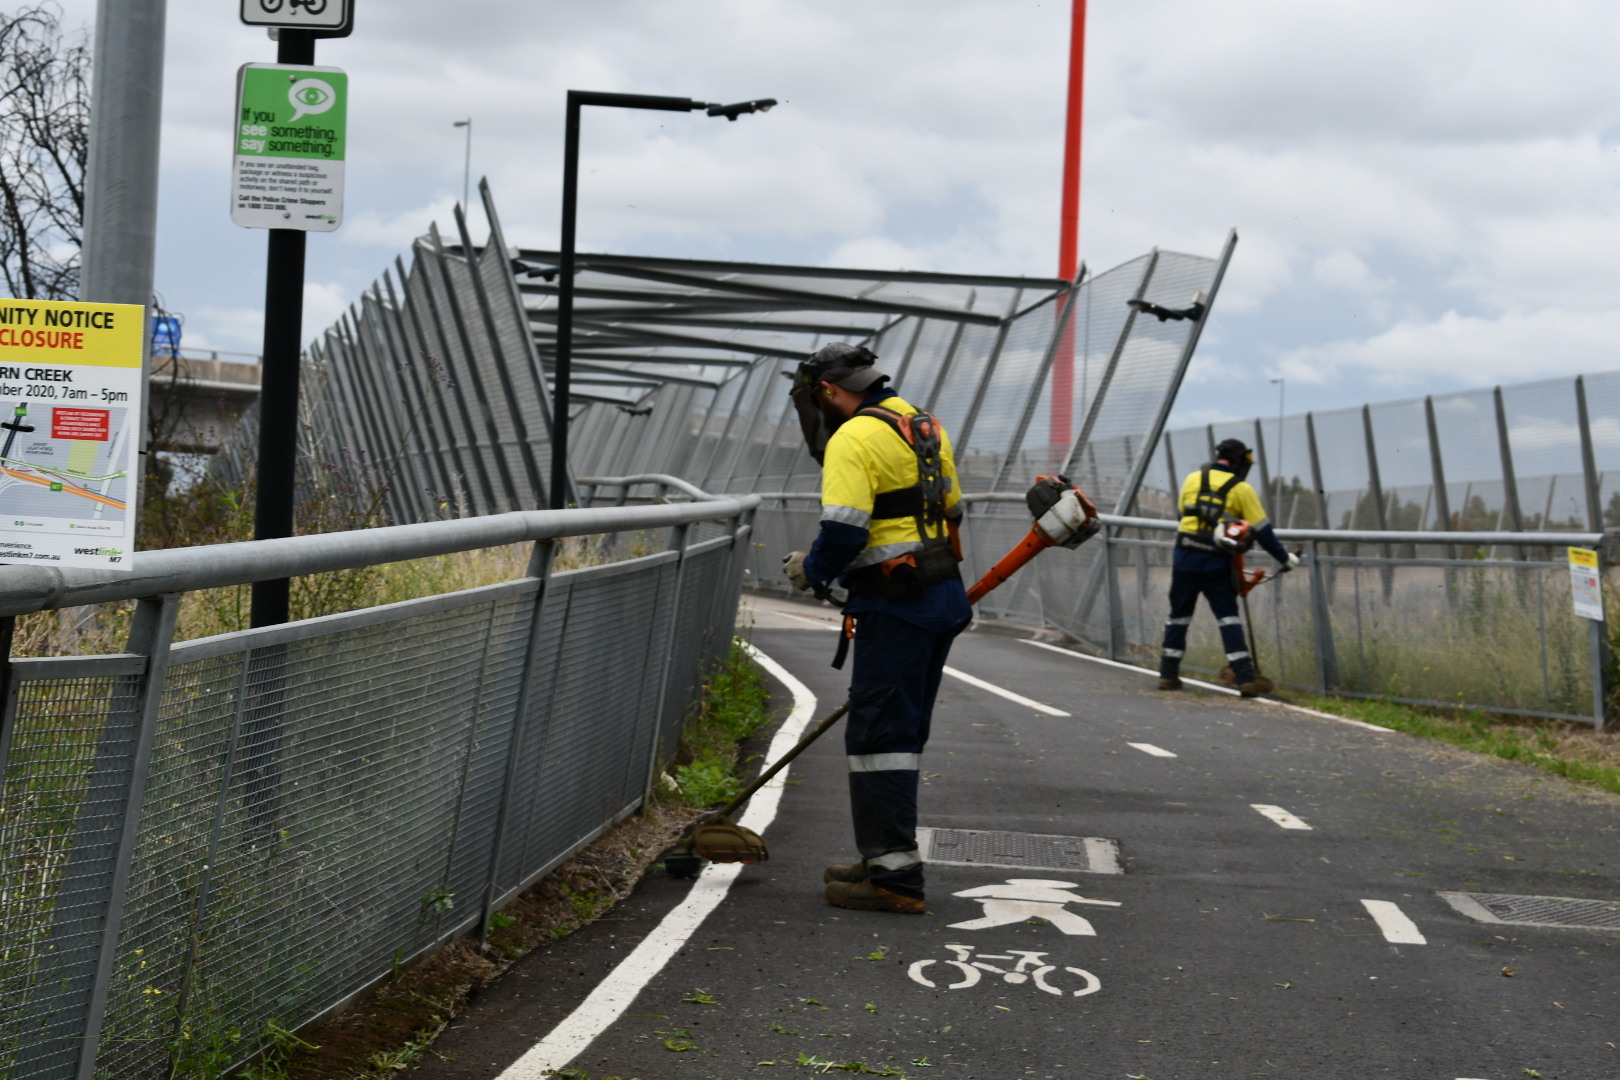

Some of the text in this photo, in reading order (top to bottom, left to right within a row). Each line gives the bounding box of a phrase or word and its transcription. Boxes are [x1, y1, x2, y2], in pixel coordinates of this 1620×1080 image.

[242, 107, 276, 124] If you
[241, 124, 338, 143] see something,
[241, 138, 335, 157] say something.
[45, 309, 114, 329] NOTICE
[0, 328, 84, 350] CLOSURE
[24, 368, 73, 382] CREEK
[0, 382, 22, 396] ber
[26, 384, 58, 400] 2020,
[62, 386, 88, 399] 7am
[101, 388, 128, 404] 5pm
[74, 547, 123, 556] westlink
